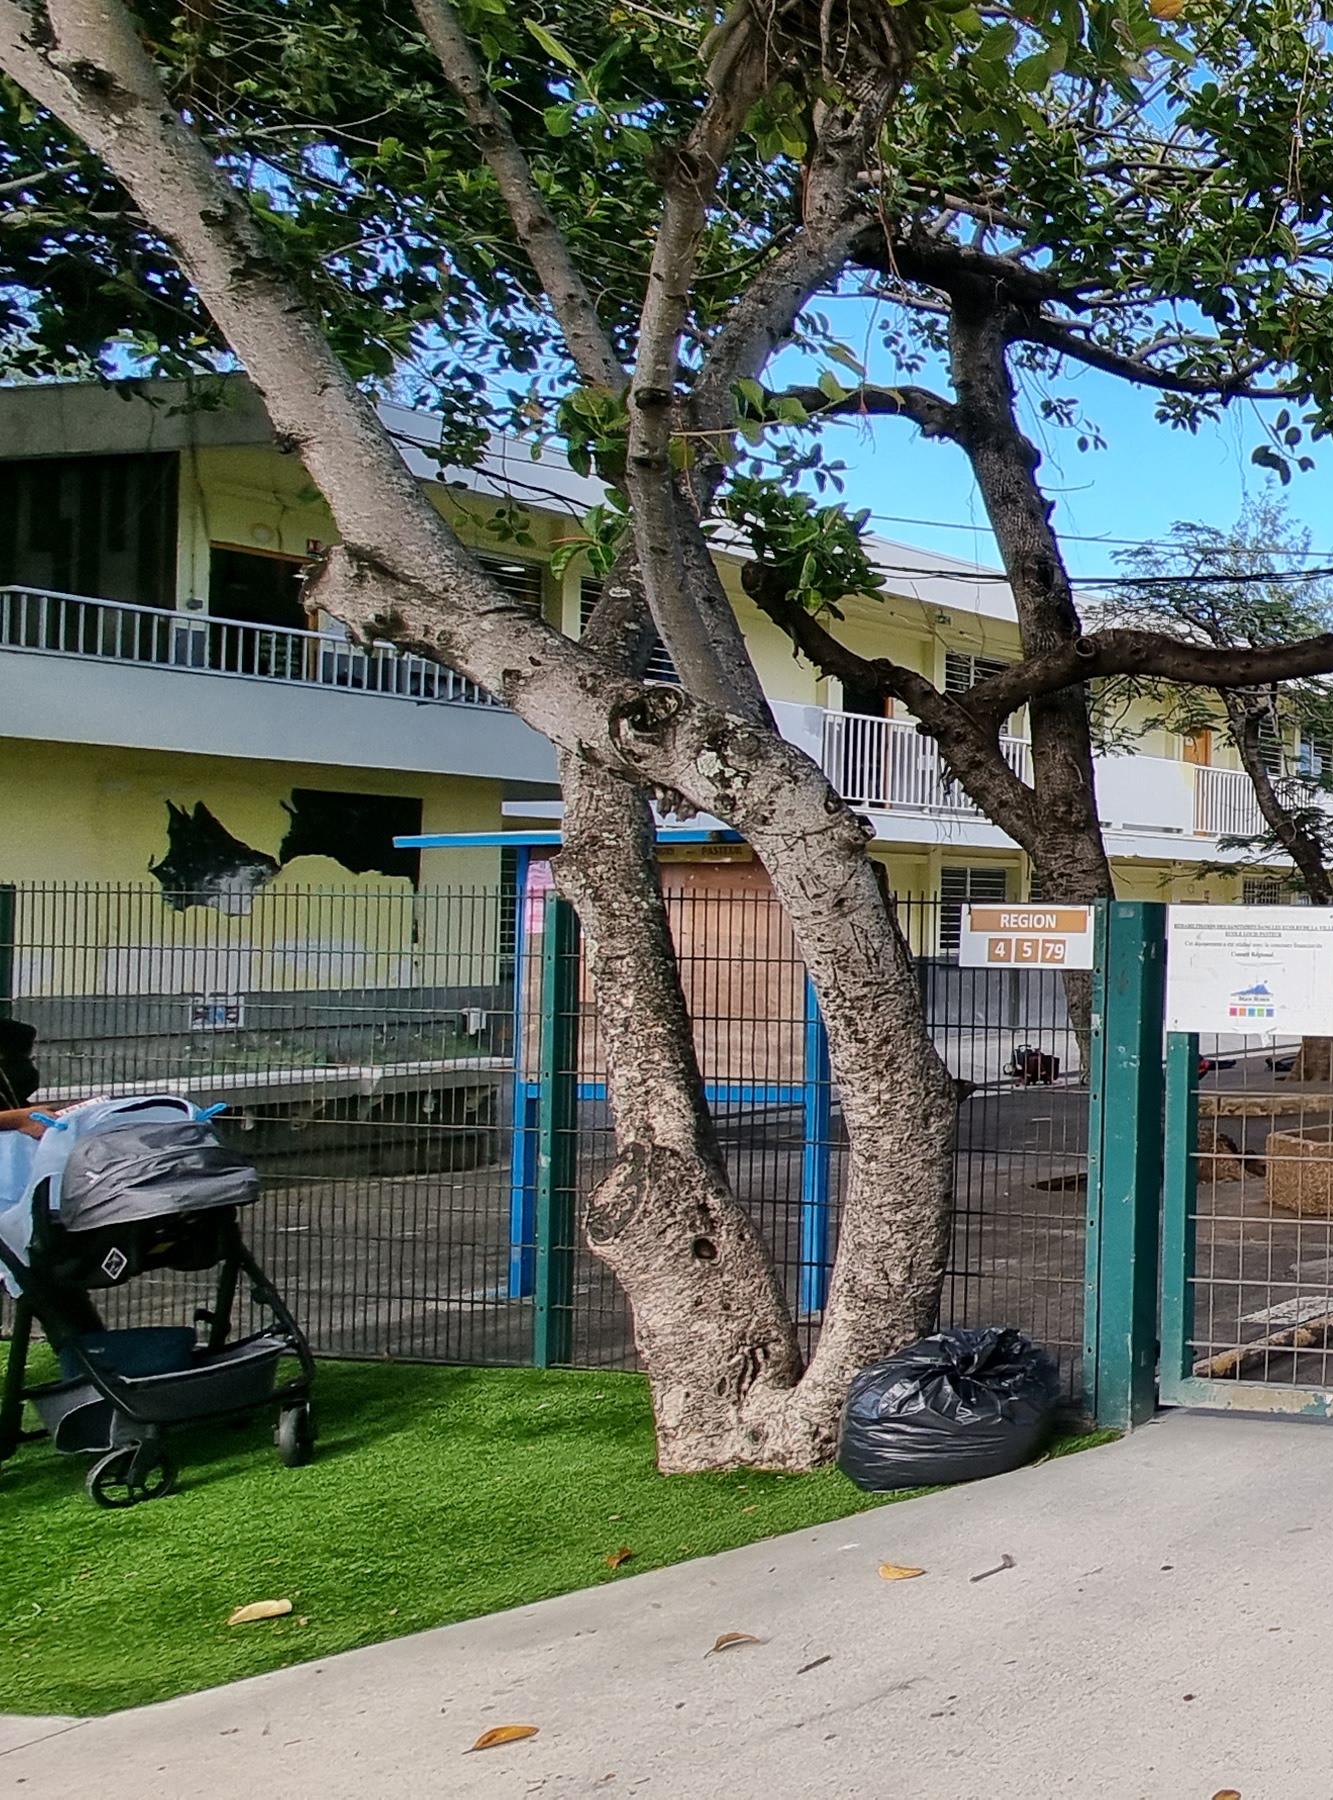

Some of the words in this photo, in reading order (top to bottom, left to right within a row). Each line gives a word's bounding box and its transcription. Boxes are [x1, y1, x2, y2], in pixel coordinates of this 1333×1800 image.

[1000, 914, 1057, 929] REGION
[994, 942, 1006, 957] 4
[1022, 942, 1032, 957] 5
[1044, 943, 1064, 960] 79
